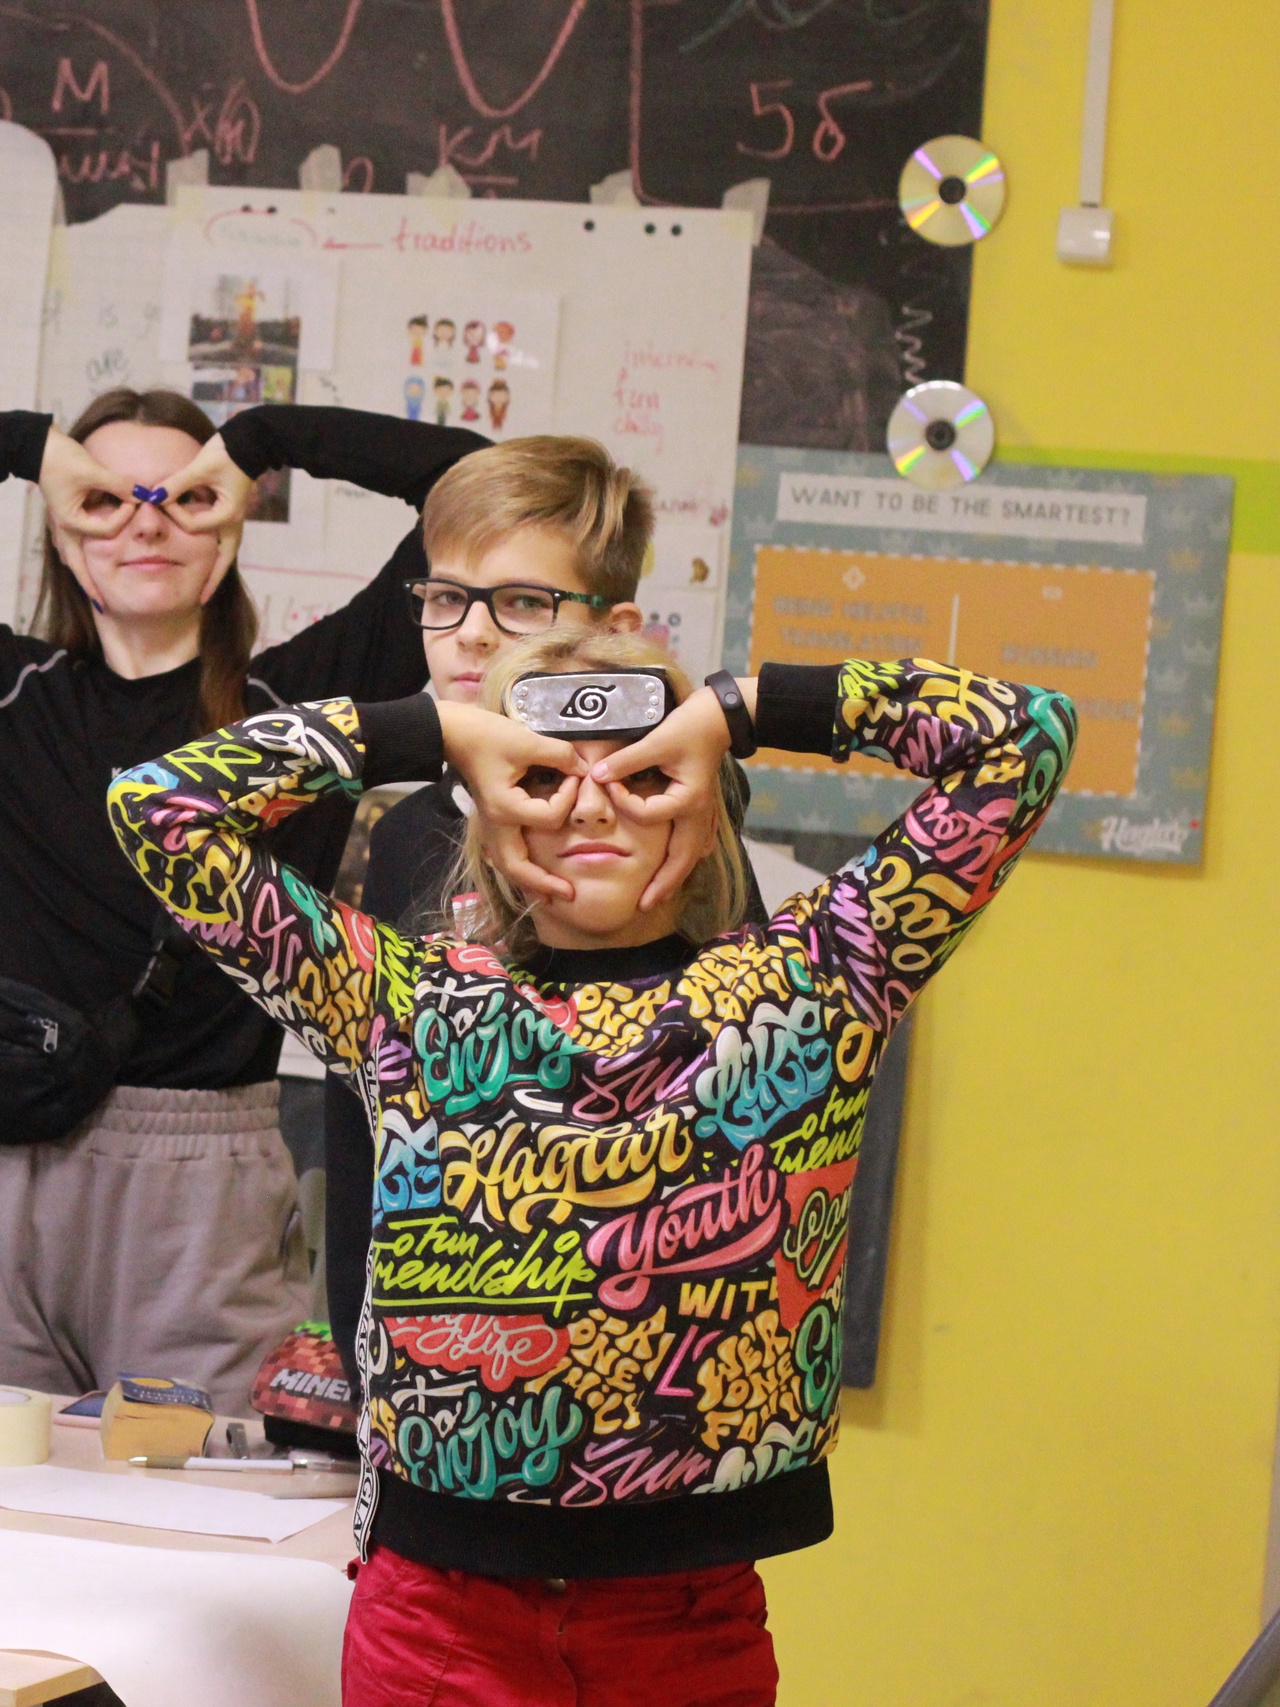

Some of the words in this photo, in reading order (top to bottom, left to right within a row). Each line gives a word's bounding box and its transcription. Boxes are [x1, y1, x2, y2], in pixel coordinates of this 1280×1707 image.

[392, 226, 533, 256] traditions
[790, 486, 862, 509] WANT
[876, 491, 903, 512] TO
[912, 494, 941, 515] BE
[951, 495, 992, 518] THE
[1001, 499, 1132, 528] SMARTEST?
[586, 1144, 800, 1311] Youth
